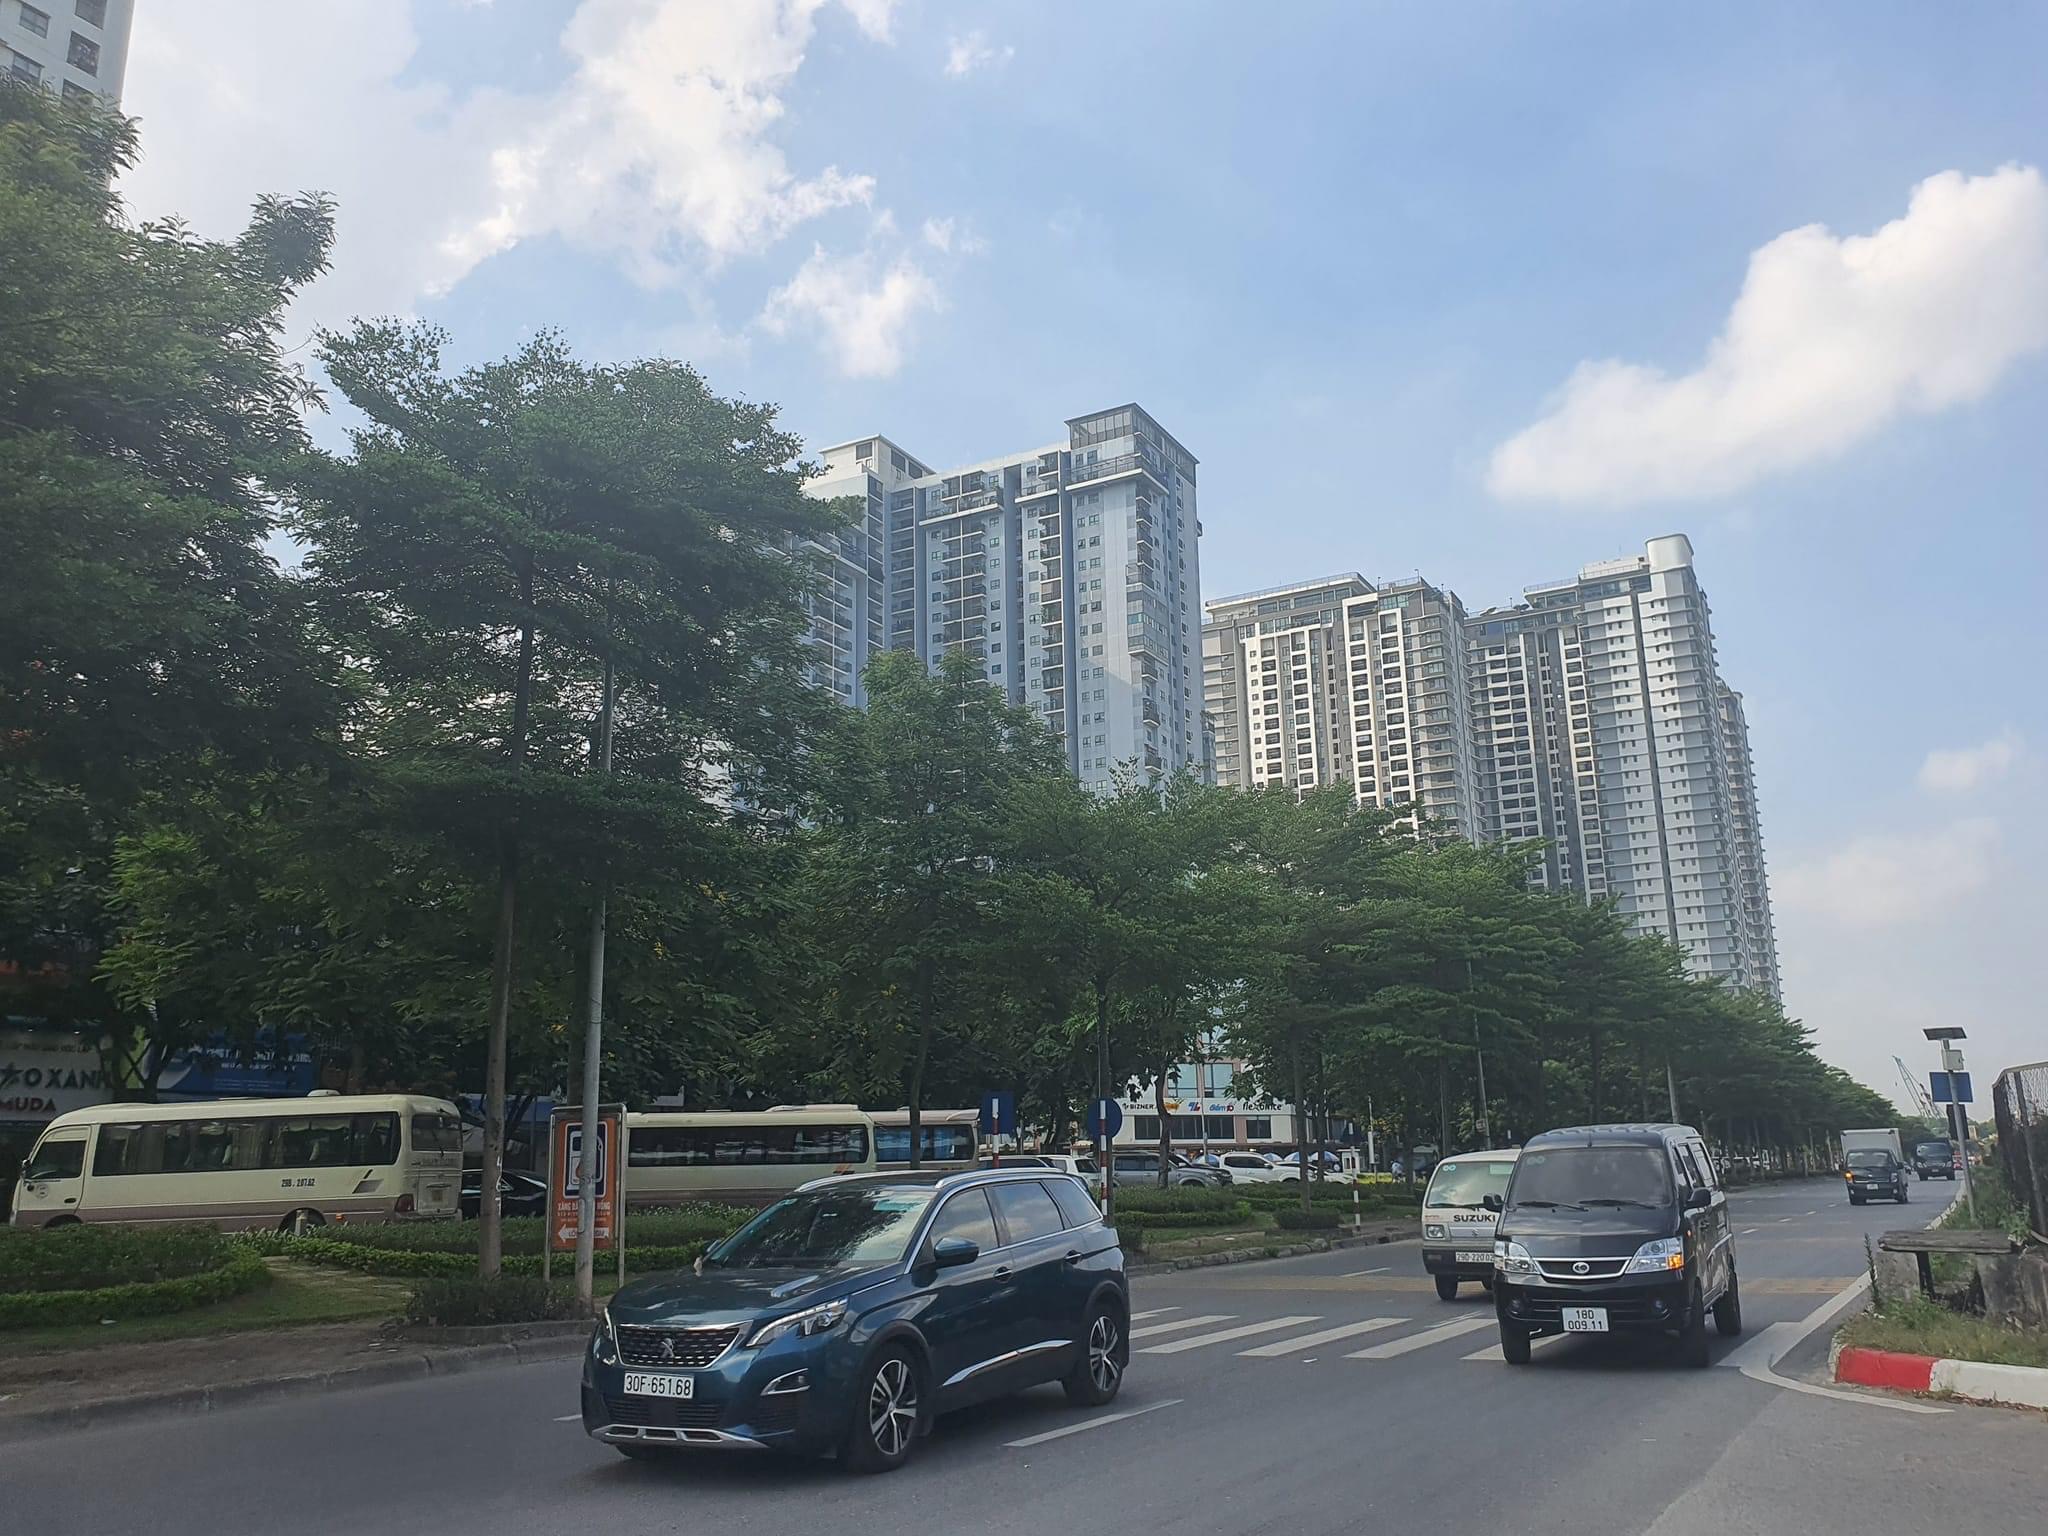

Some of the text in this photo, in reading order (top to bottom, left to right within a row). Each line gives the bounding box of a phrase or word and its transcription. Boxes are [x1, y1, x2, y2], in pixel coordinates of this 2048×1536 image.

[1453, 1214, 1496, 1222] SUZUKI
[1576, 1309, 1595, 1319] 18D
[626, 1374, 691, 1396] 30F-651.68
